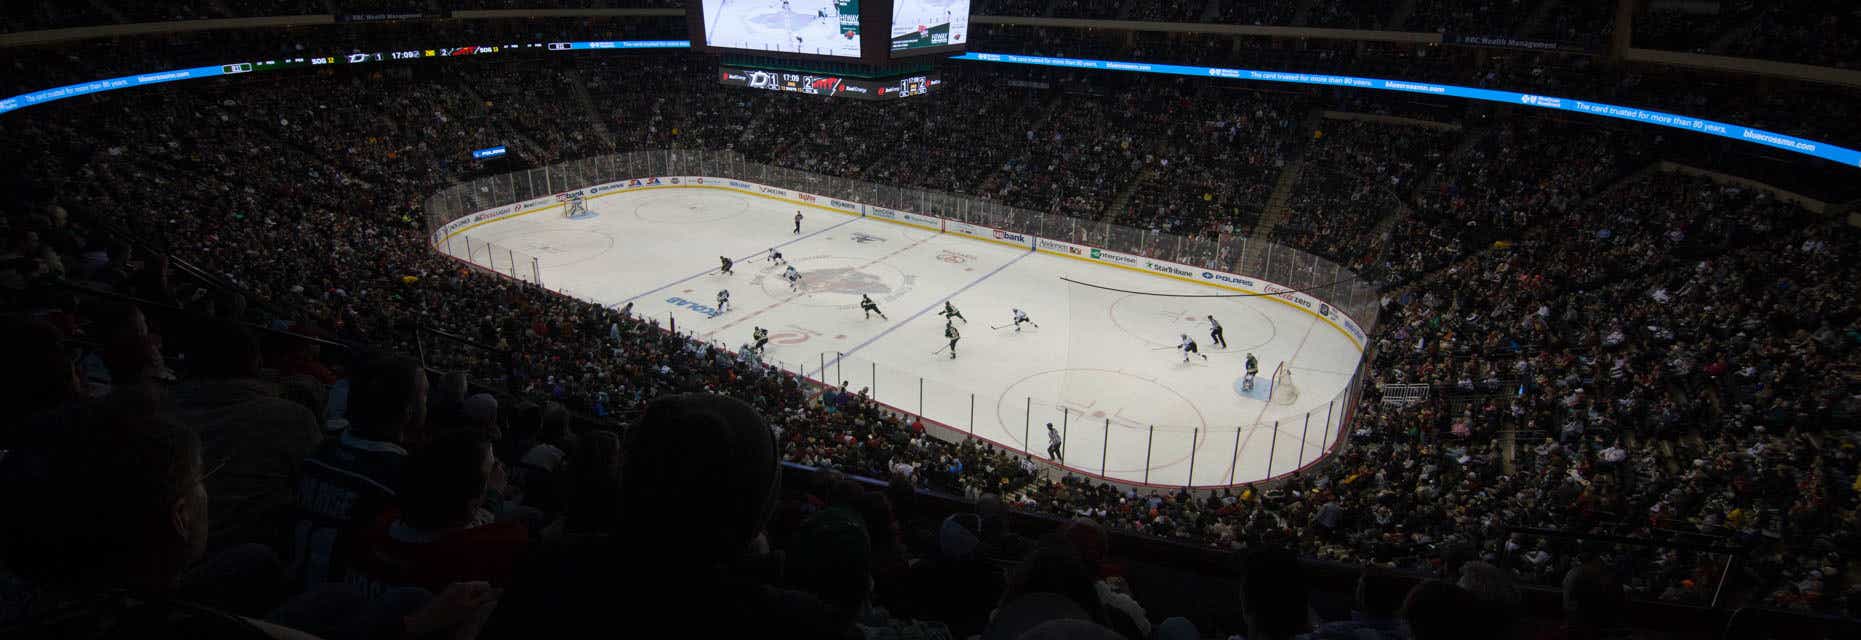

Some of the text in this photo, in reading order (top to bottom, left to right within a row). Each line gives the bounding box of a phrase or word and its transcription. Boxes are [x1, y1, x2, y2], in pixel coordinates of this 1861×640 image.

[783, 74, 799, 82] 17:09
[1576, 102, 1591, 110] The
[1592, 104, 1609, 113] card
[1610, 106, 1637, 117] trusted
[1639, 110, 1650, 119] for
[1651, 114, 1672, 124] more
[1674, 117, 1691, 127] than
[1743, 130, 1816, 151] bluecrossmn.com
[1154, 263, 1193, 277] StarTribune
[1215, 274, 1253, 287] POLARIS
